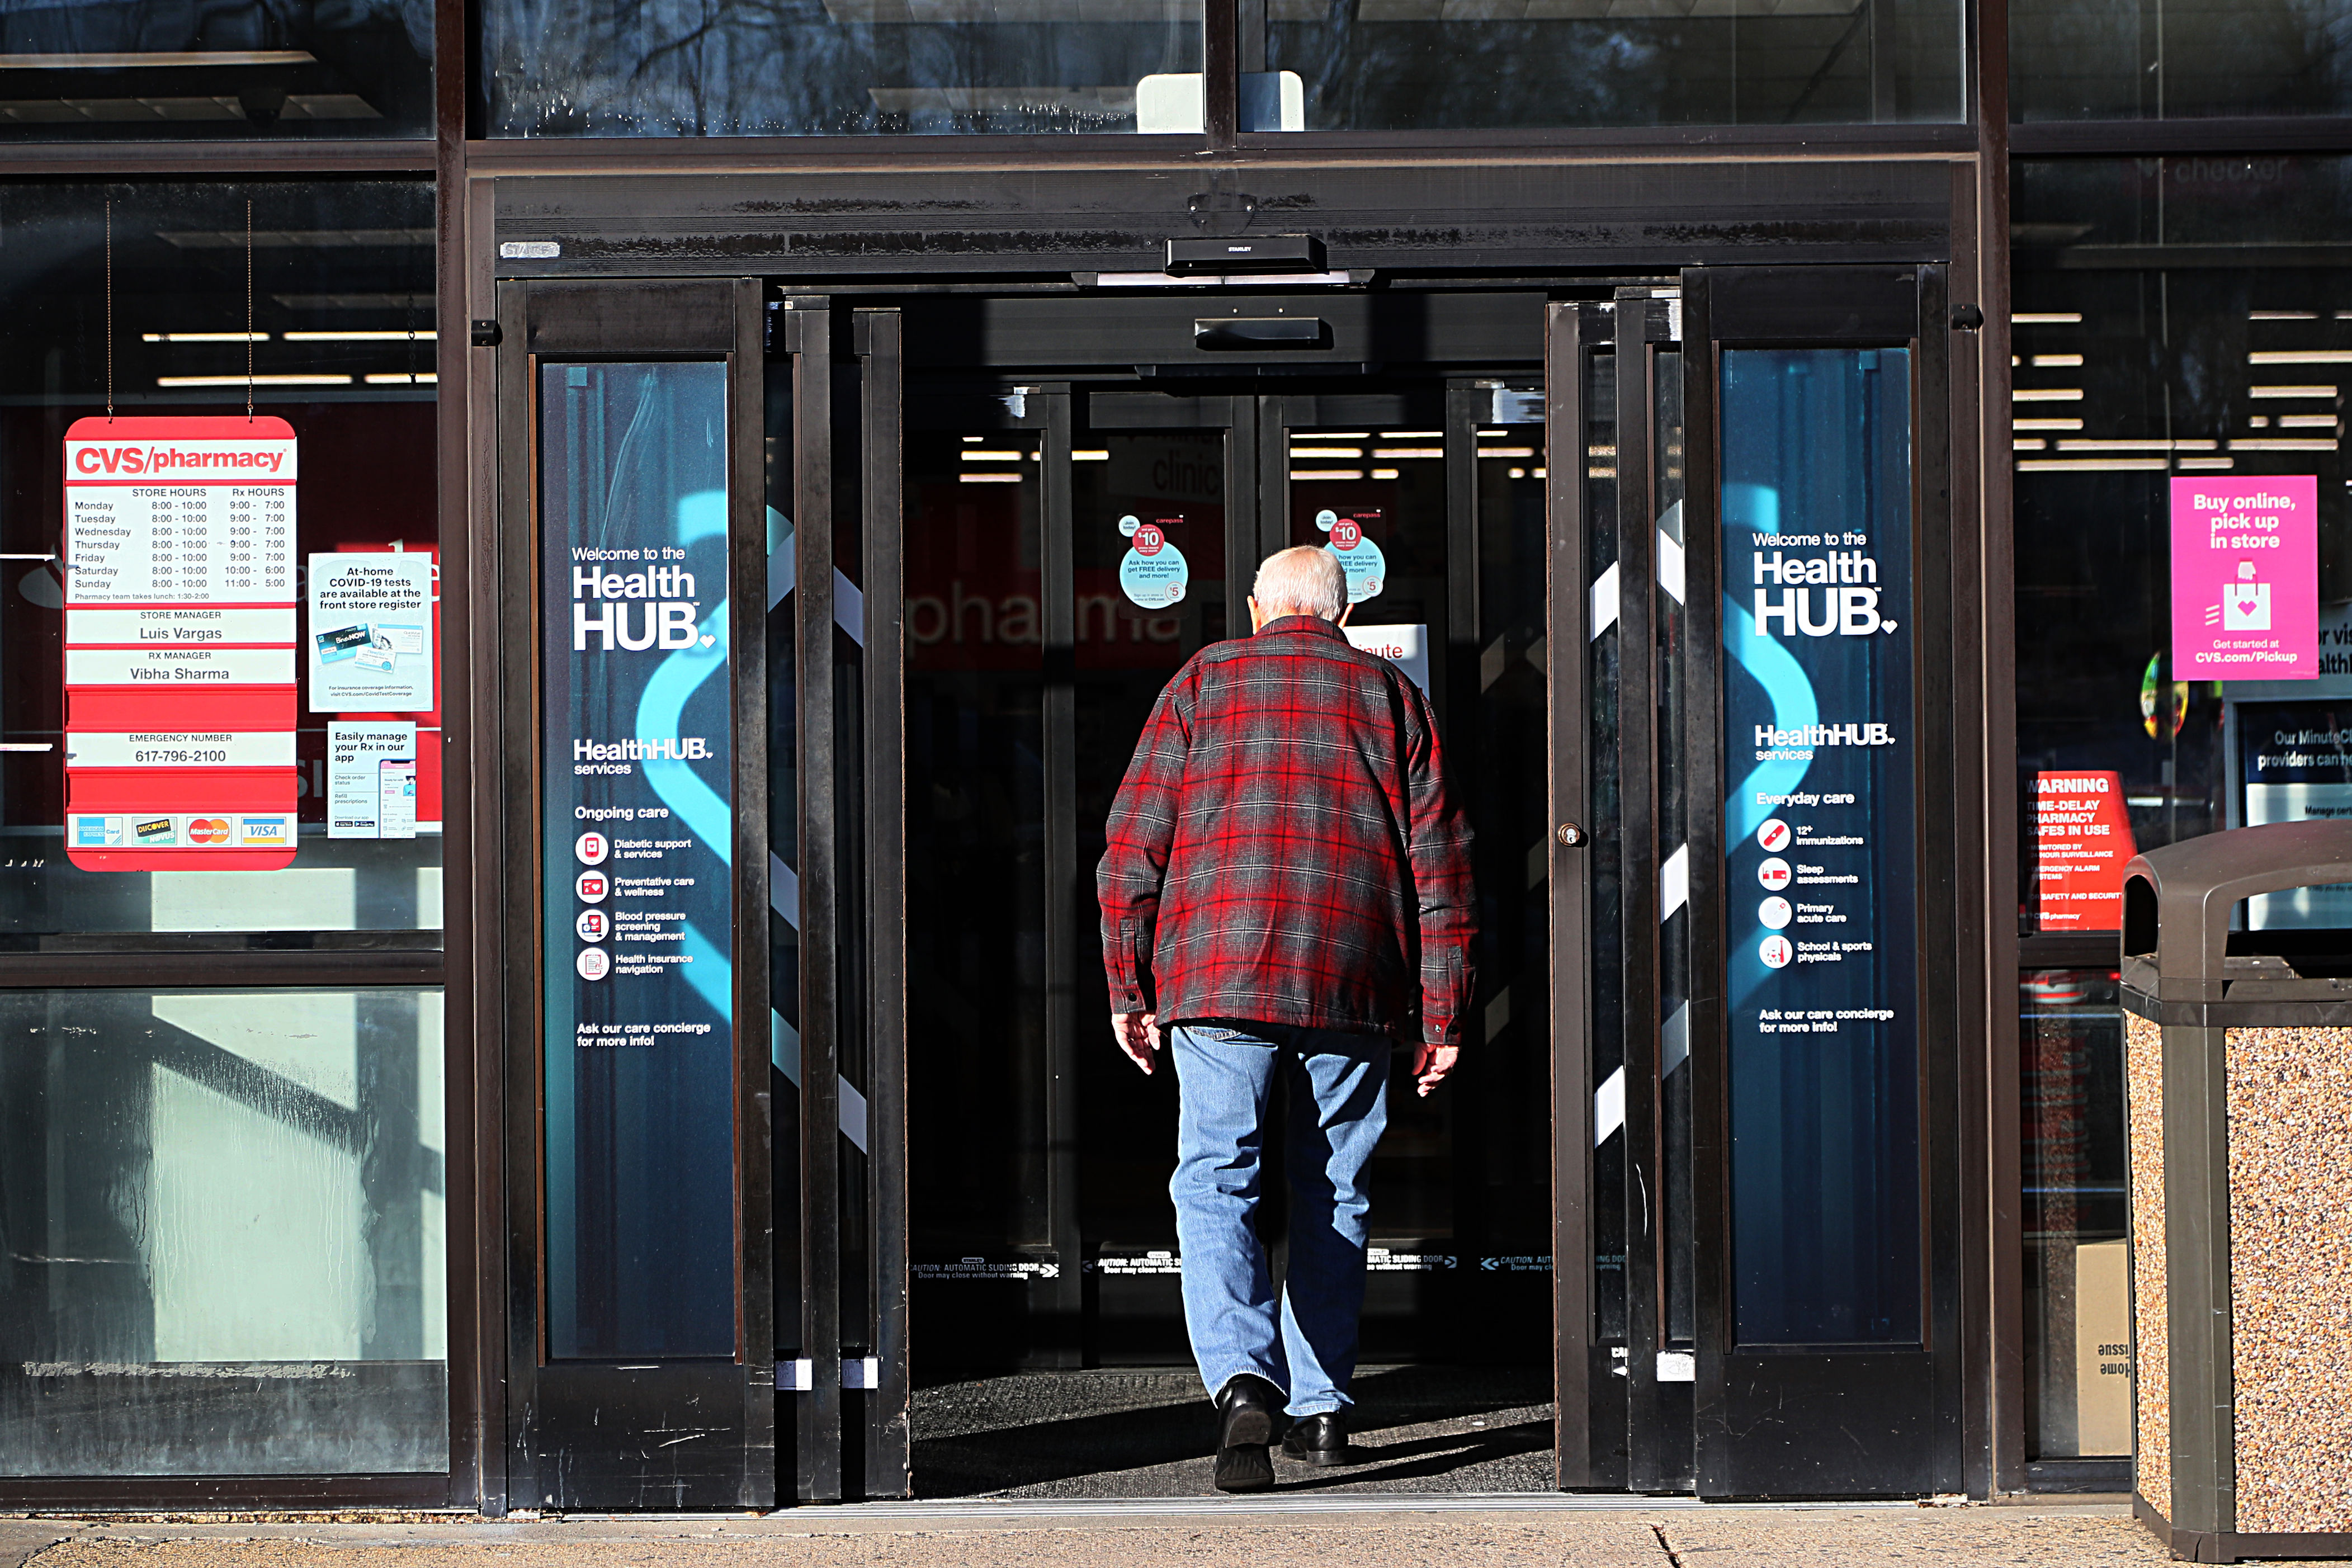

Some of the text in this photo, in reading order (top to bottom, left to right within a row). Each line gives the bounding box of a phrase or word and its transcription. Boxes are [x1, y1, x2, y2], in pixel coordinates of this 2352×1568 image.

[75, 502, 113, 511] Monday
[2194, 492, 2296, 514] Buy online,
[2211, 513, 2279, 532] pick up
[1138, 532, 1159, 546] $10
[1753, 532, 1866, 546] Welcome to the
[2211, 532, 2280, 548] in store
[75, 554, 105, 563] Friday
[572, 546, 685, 560] Welcome to the
[75, 566, 118, 576] Saturday
[1754, 550, 1876, 584] Health
[75, 580, 111, 589] Sunday
[574, 565, 695, 598] Health
[340, 589, 388, 598] available
[320, 601, 346, 609] front
[380, 600, 421, 610] register
[141, 628, 221, 641] Luis Vargas
[2213, 639, 2279, 649] Get started at
[2195, 651, 2297, 664] CVS.com/Pickup
[130, 668, 229, 679] Vibha Sharma
[336, 732, 364, 742] Easily
[2275, 729, 2296, 745] Our
[136, 750, 225, 762] 617-796-2100
[1756, 748, 1813, 761] services
[2257, 750, 2337, 771] providers can
[574, 762, 631, 774] services
[1756, 792, 1854, 807] Everyday care
[575, 806, 668, 821] Ongoing care
[190, 827, 229, 835] MasterCard
[249, 826, 278, 835] VISA
[2068, 825, 2081, 836] IN
[2084, 825, 2110, 836] USE
[615, 839, 691, 850] Diabetic support
[615, 849, 662, 858] & services
[615, 877, 671, 886] Preventative
[615, 887, 664, 896] & wellness
[615, 911, 686, 923] Blood pressure
[615, 921, 660, 933] screening
[625, 933, 685, 942] management
[616, 955, 693, 964] Health insurance
[616, 965, 663, 975] navigation
[577, 1022, 711, 1035] Ask our care concierge
[577, 1036, 654, 1046] for more info!
